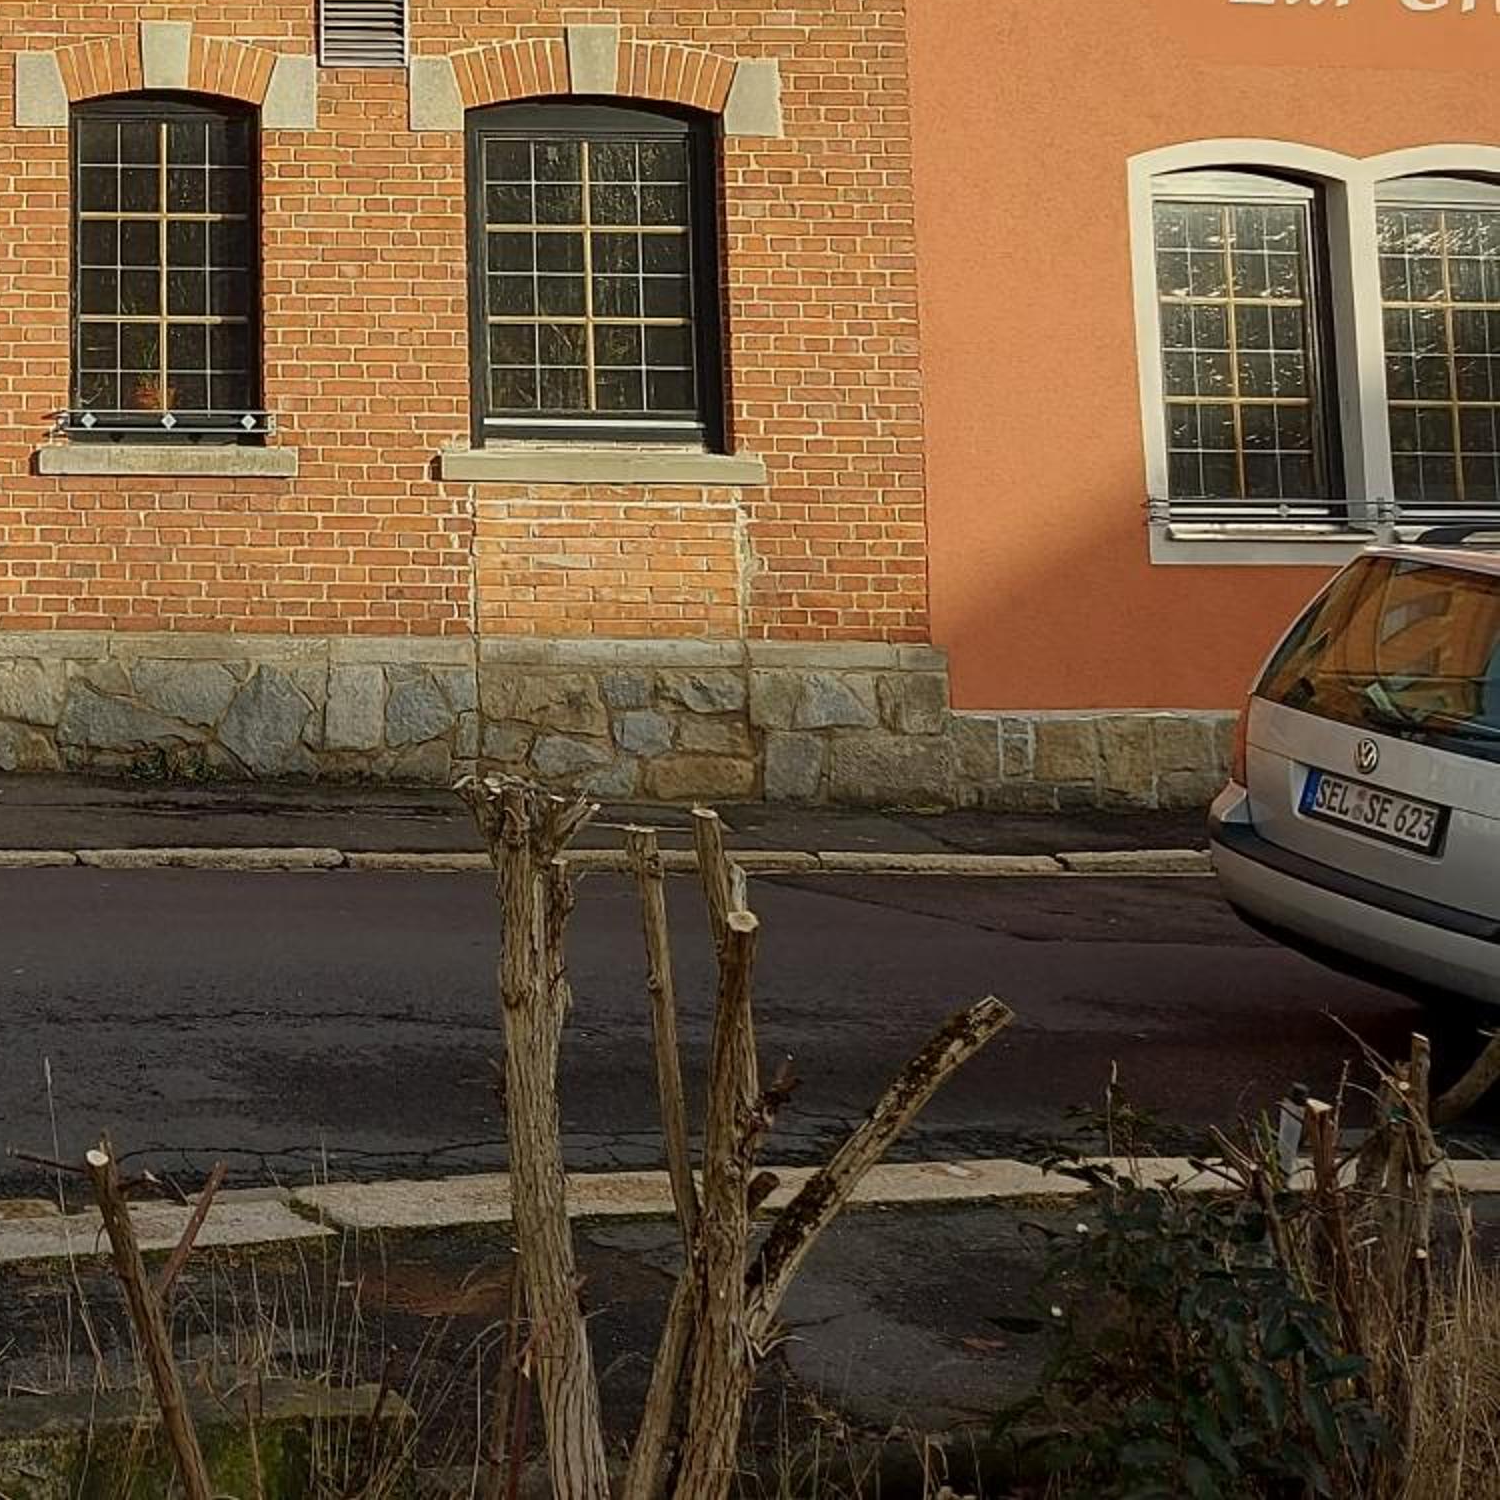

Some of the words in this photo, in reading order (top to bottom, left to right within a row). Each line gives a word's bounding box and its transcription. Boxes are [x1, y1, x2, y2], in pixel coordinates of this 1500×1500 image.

[1316, 779, 1349, 817] SEL
[1363, 793, 1393, 829] SE
[1394, 803, 1435, 841] 623
